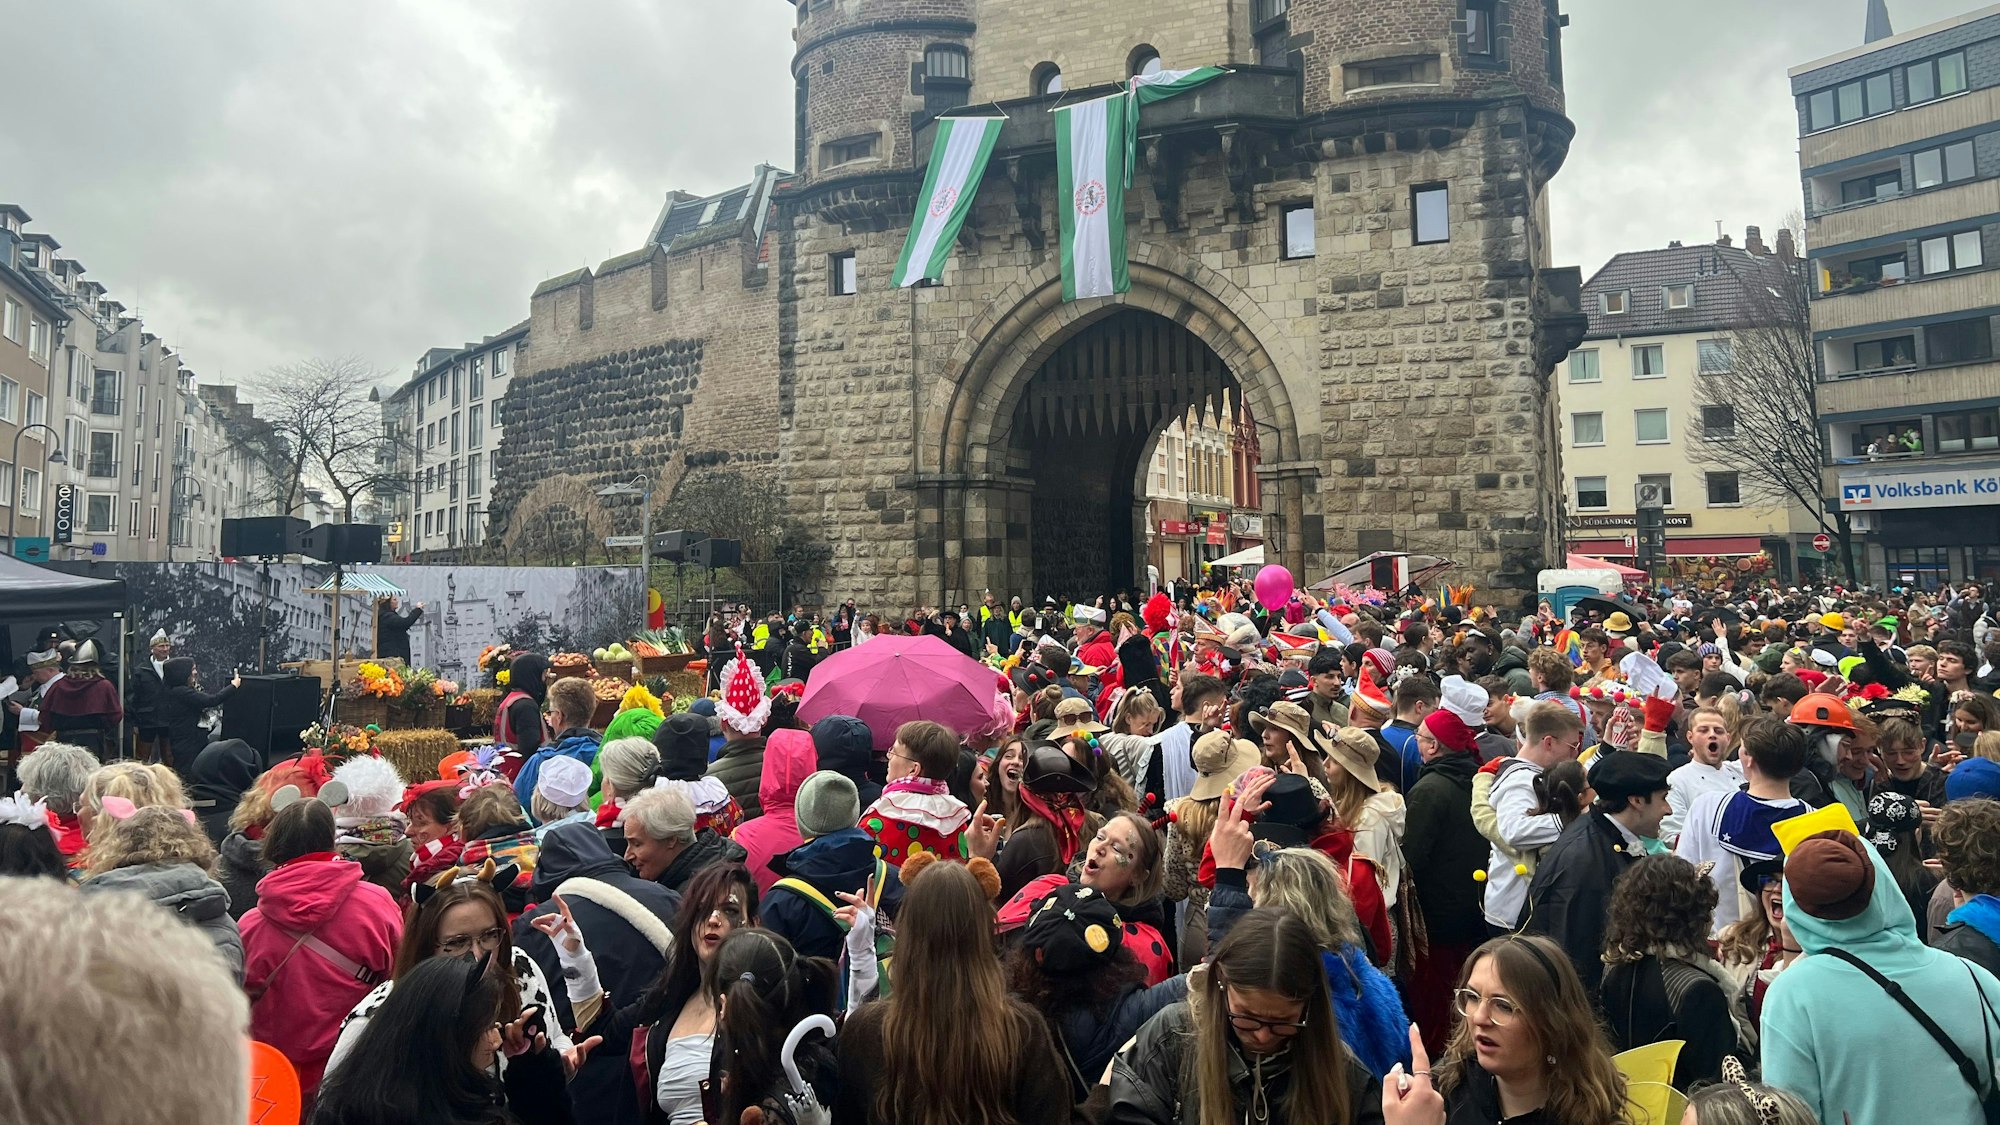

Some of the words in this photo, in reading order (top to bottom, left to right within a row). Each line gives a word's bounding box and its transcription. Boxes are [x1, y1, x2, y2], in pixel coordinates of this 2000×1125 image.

[1875, 479, 1968, 498] Volksbank
[1583, 518, 1637, 526] SÜDLÄNDISC
[1665, 517, 1688, 525] KOST
